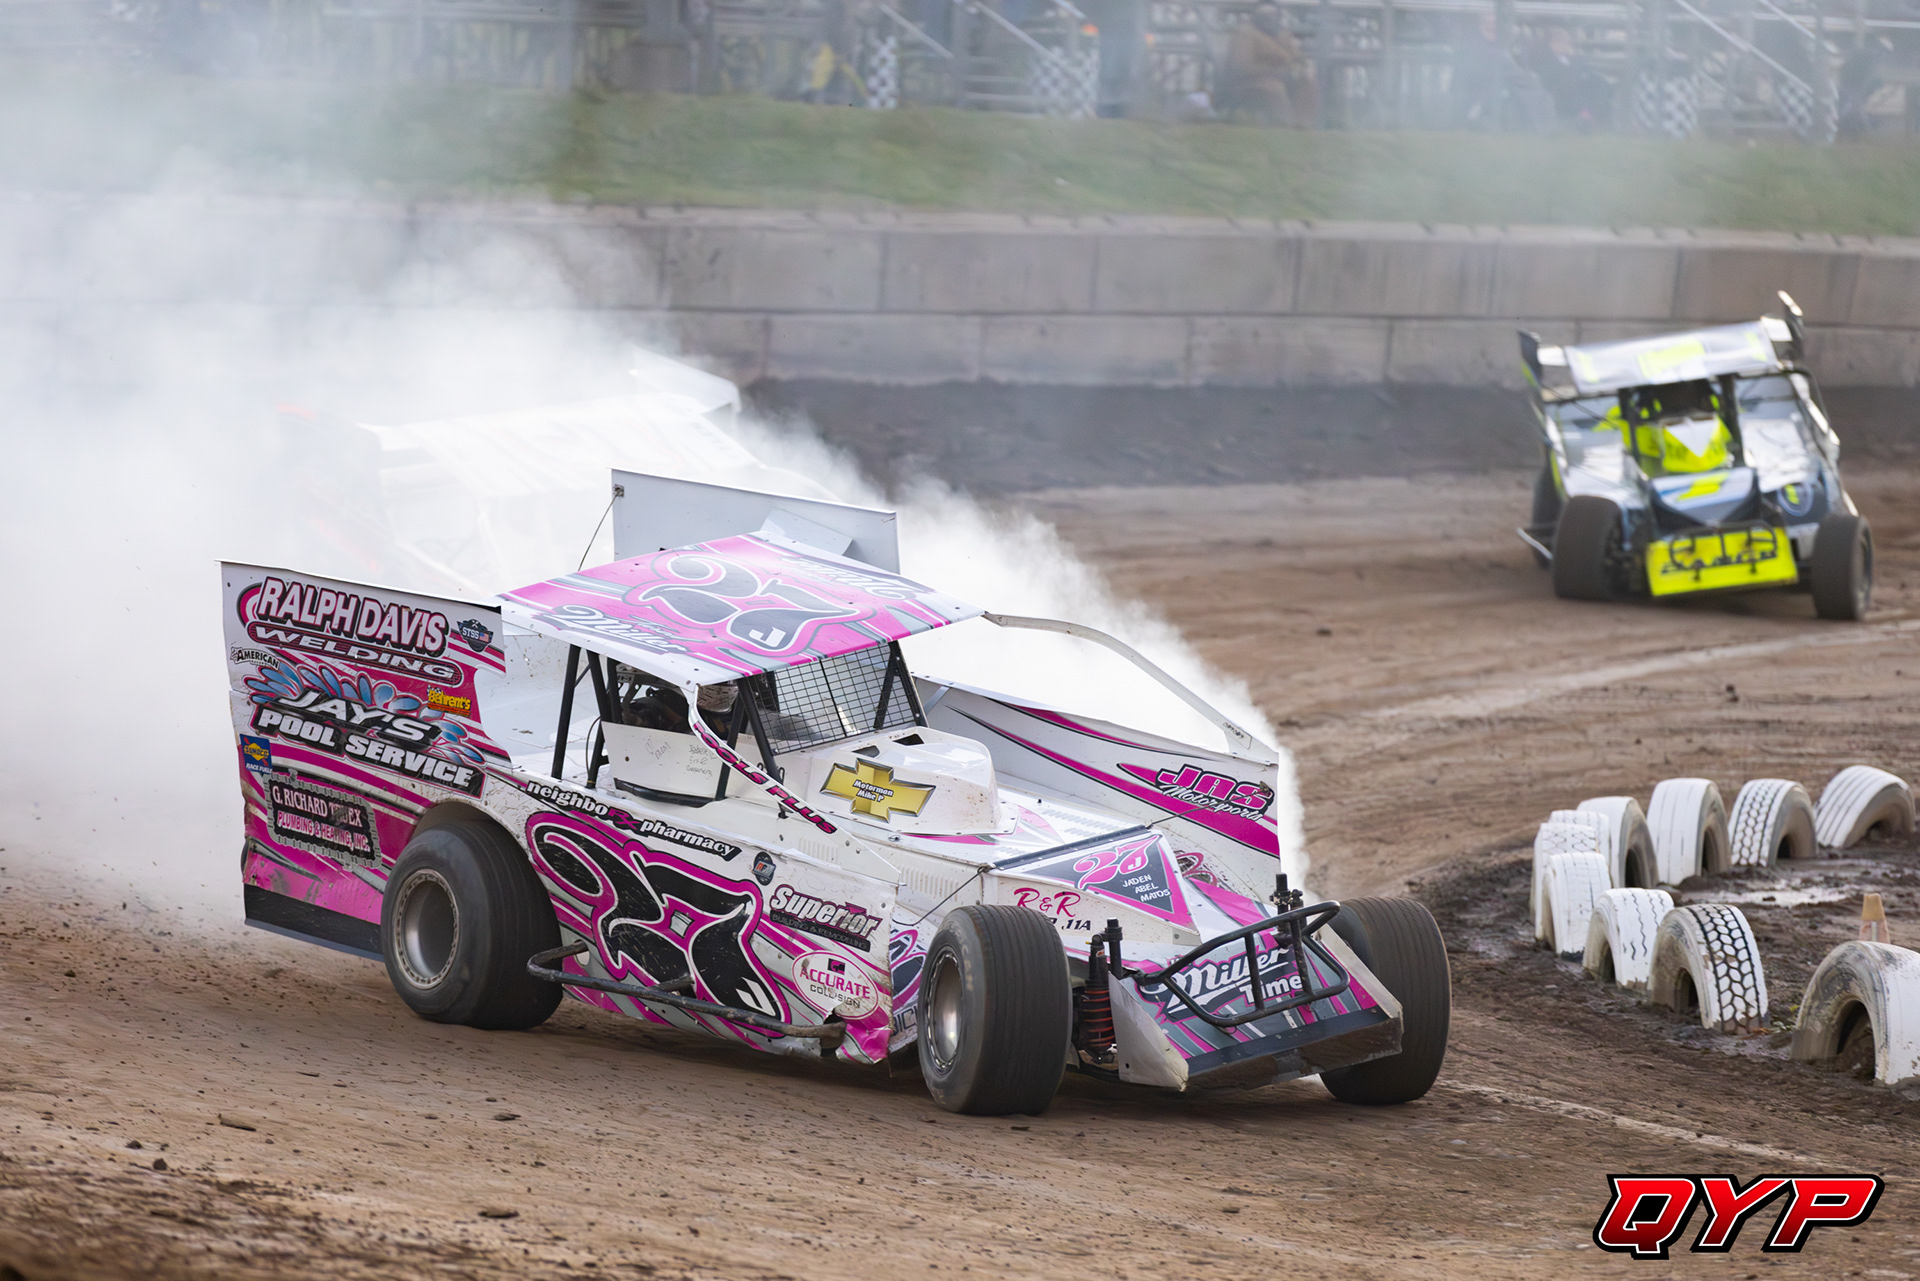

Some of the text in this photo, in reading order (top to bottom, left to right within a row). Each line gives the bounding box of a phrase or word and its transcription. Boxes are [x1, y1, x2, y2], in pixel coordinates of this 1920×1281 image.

[257, 576, 448, 653] RALPH DAVIS
[638, 553, 860, 652] 27
[253, 626, 455, 680] WELDING
[462, 627, 480, 640] STSS
[236, 649, 280, 671] AMERICAN
[278, 690, 432, 742] JAY'S
[428, 689, 471, 710] Behrent's
[246, 763, 259, 771] RACE
[257, 707, 474, 788] POOL SERVICE
[693, 721, 769, 784] POOLS
[766, 785, 838, 834] PLUS
[853, 780, 895, 798] Motorman
[856, 789, 886, 803] Mike P
[1158, 765, 1273, 811] JAS
[272, 785, 283, 804] G.
[283, 788, 328, 817] RICHARD
[1162, 783, 1263, 822] Motorsports
[277, 810, 315, 836] PLUMBING
[314, 821, 321, 838] &
[353, 832, 371, 852] INC.
[640, 818, 735, 857] pharmacy
[1073, 834, 1161, 890] 27 J
[1122, 874, 1152, 888] JADEN
[1134, 882, 1160, 894] ABEL
[1140, 888, 1171, 902] MATOS
[527, 815, 786, 1026] 27
[771, 886, 882, 938] Superior
[772, 914, 868, 950] BUILDING & REMODELING
[800, 968, 871, 1000] ACCURATE
[1140, 947, 1290, 1010] Miller
[1239, 974, 1303, 1003] Time
